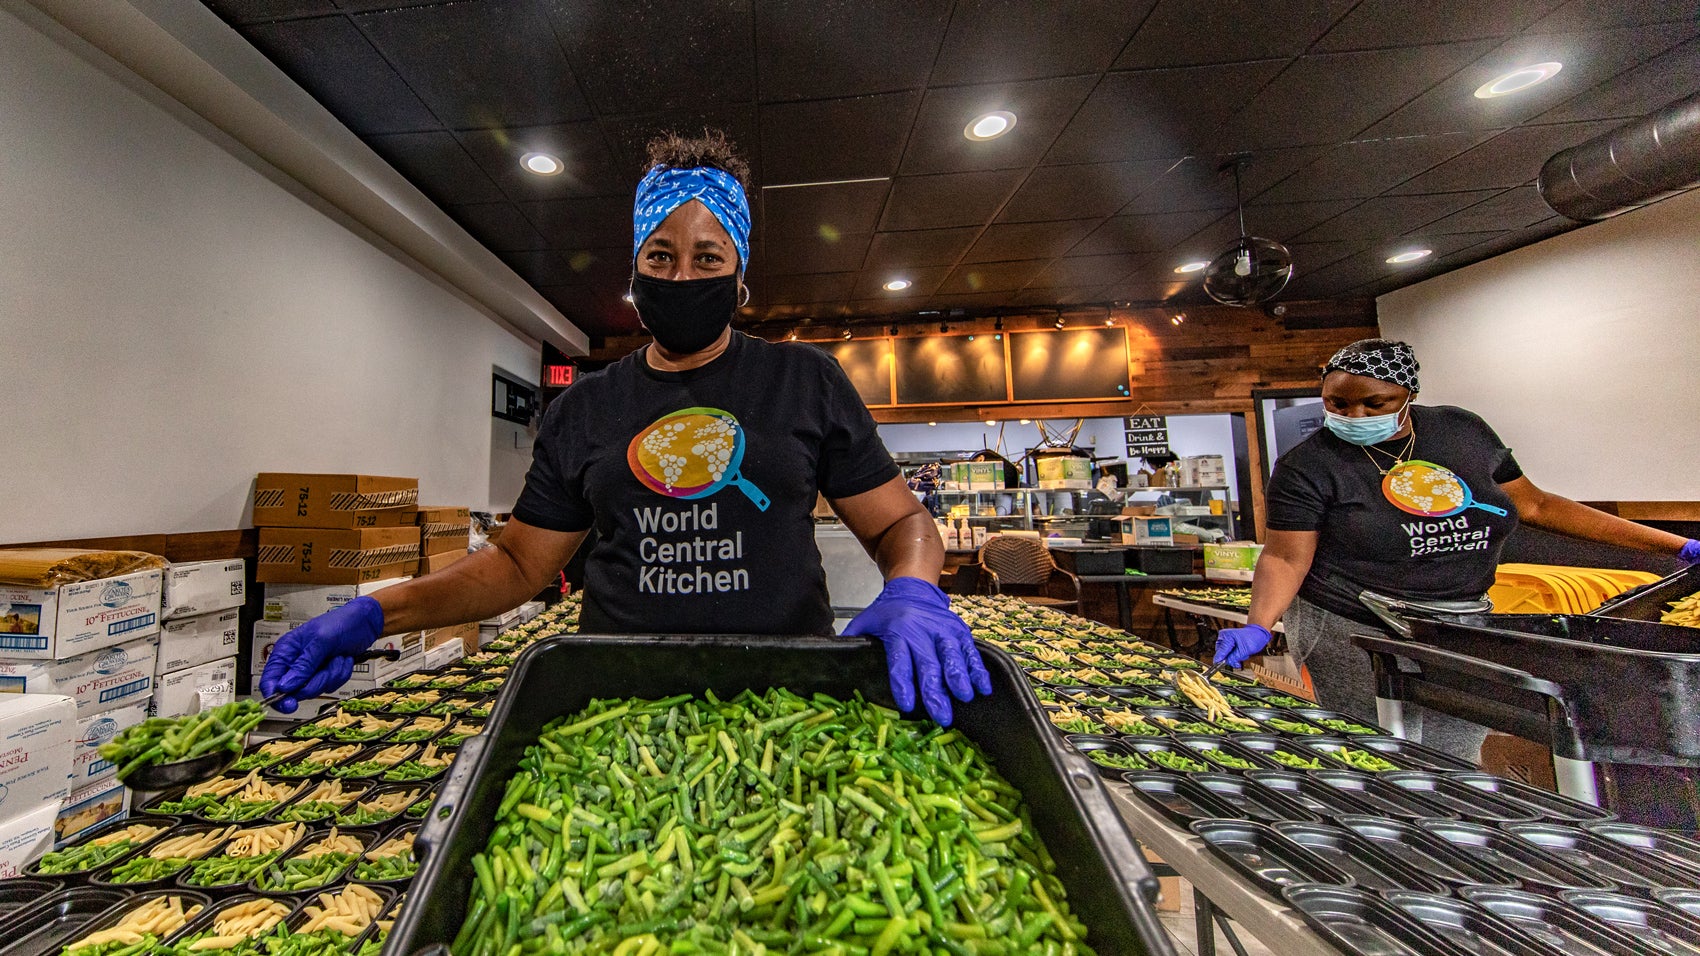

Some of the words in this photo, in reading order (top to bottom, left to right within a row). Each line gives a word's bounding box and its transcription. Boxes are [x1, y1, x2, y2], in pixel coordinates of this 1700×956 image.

[1130, 417, 1161, 429] EAT
[1128, 432, 1155, 443] Drink
[1156, 431, 1165, 441] &
[1141, 445, 1166, 455] Happy
[297, 487, 310, 516] 75-12
[356, 515, 377, 527] 75-12
[633, 502, 719, 534] World
[1400, 515, 1470, 537] World
[639, 531, 743, 564] Central
[1409, 526, 1491, 549] Central
[301, 541, 313, 573] 75-12
[1214, 550, 1240, 558] VINYL
[361, 568, 381, 581] 75-12
[638, 565, 750, 594] Kitchen
[100, 606, 147, 623] FETTUCCINE
[92, 671, 142, 691] FETTUCCINE
